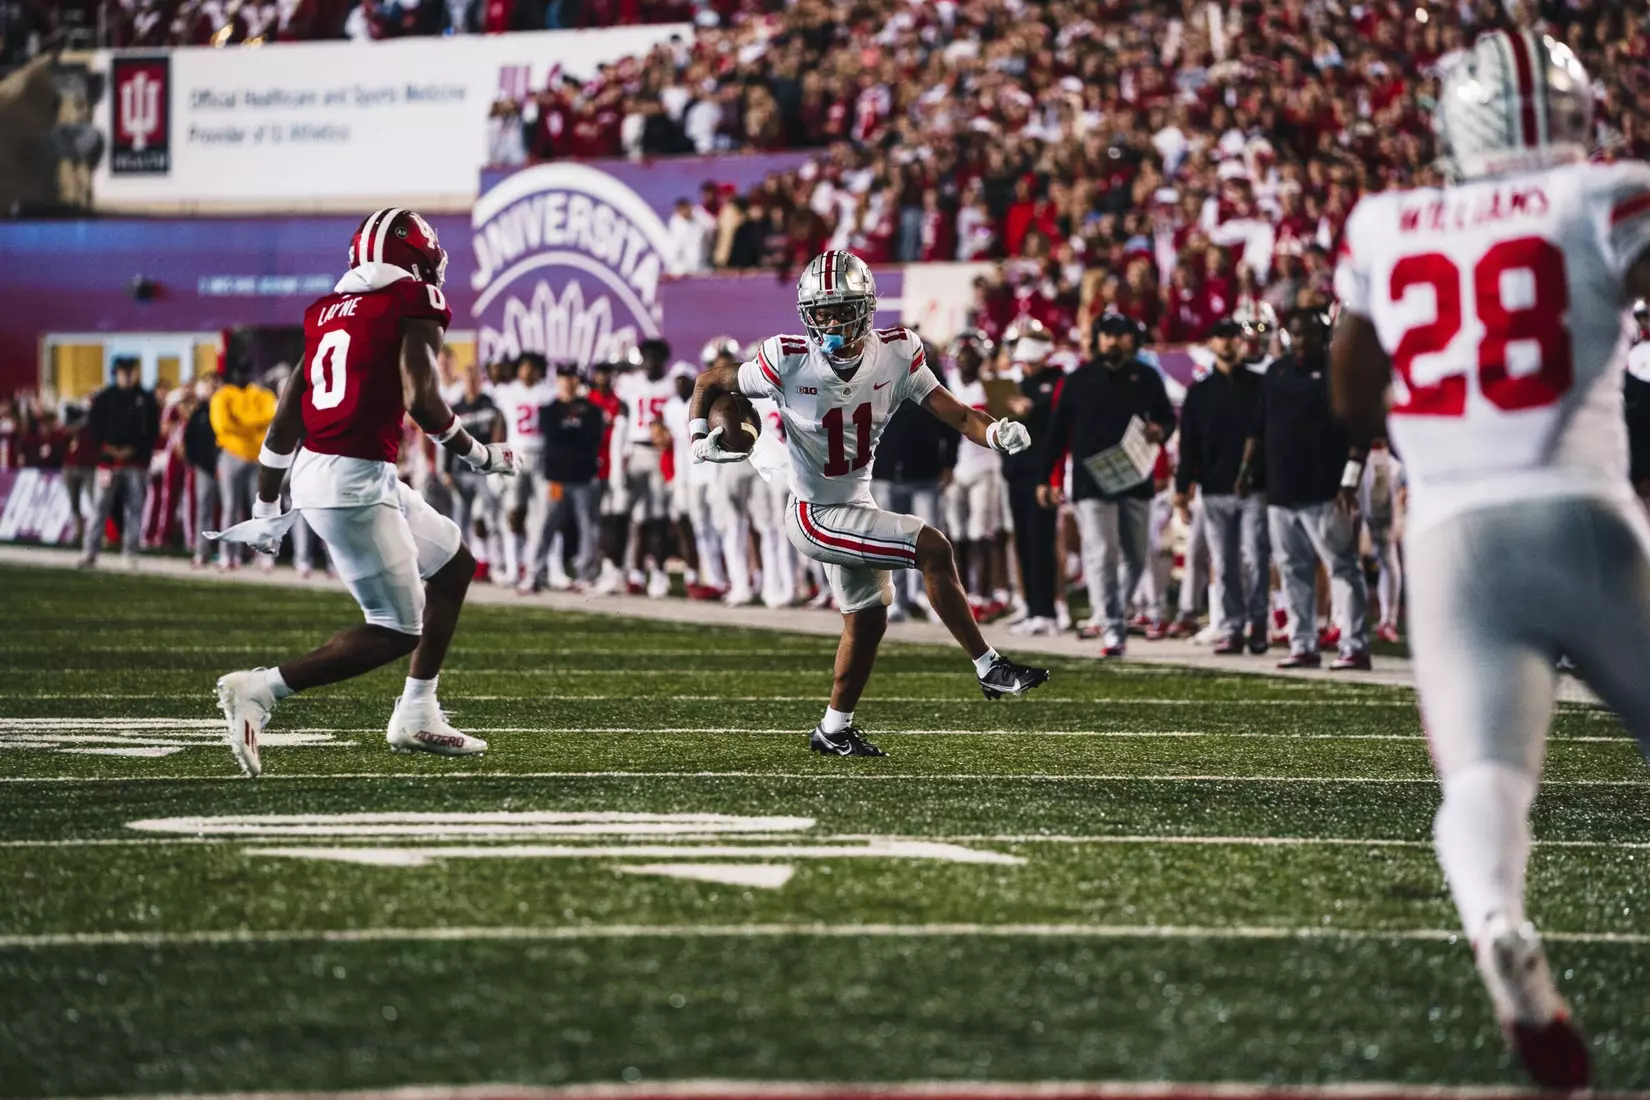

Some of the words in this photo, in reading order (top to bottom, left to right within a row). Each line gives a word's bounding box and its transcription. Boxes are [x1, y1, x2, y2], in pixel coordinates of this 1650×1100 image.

[317, 296, 362, 327] LAYNE
[426, 283, 446, 311] 0
[1390, 236, 1574, 417] 28
[311, 329, 351, 411] 0
[822, 402, 873, 477] 11
